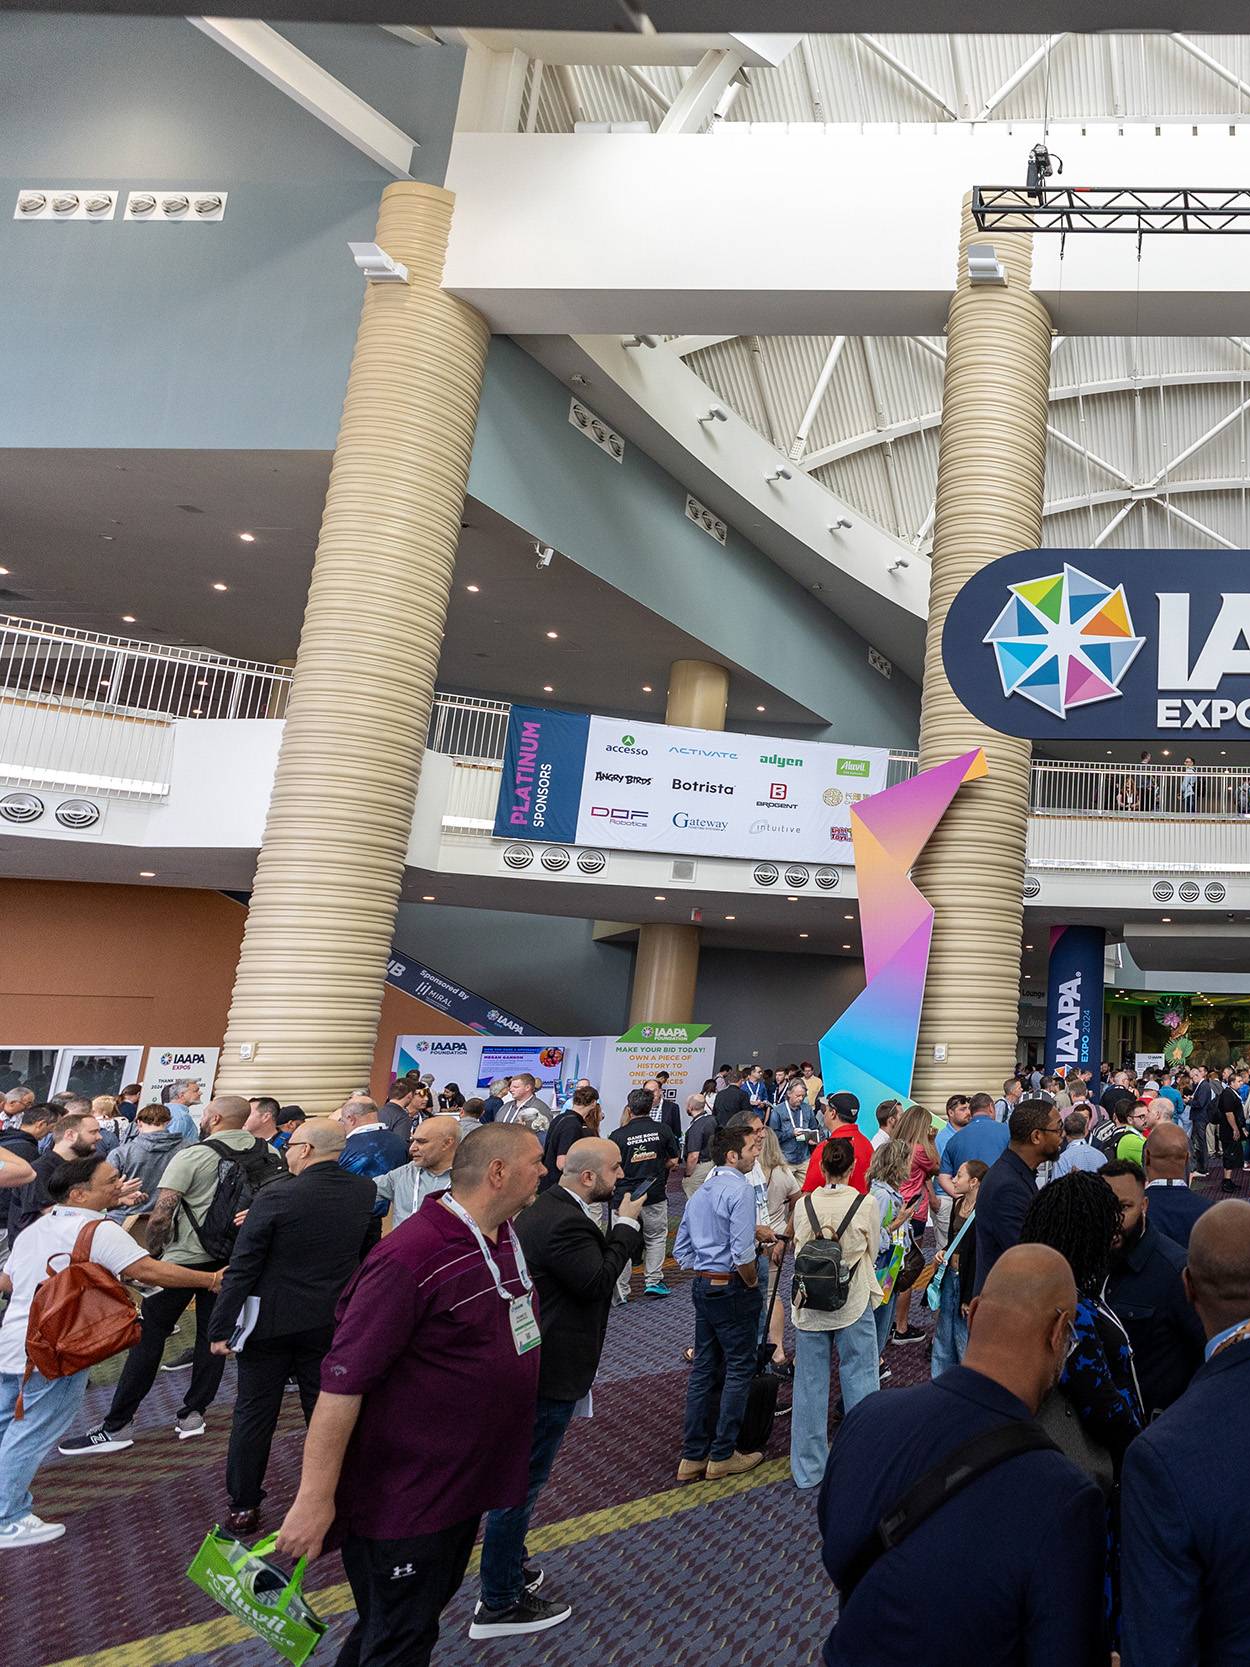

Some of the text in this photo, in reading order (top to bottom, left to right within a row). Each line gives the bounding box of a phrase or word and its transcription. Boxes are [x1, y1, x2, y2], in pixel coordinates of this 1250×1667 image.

[605, 743, 649, 756] accesso
[759, 754, 803, 768] adyen
[510, 721, 542, 826] PLATINUM
[595, 771, 652, 786] ANGRY BIRDS
[672, 779, 735, 795] Botrista
[533, 763, 552, 828] SPONSORS
[756, 800, 798, 810] BROGENT
[591, 806, 649, 820] DOF
[609, 818, 647, 828] Robotics
[672, 812, 729, 831] Gateway
[756, 823, 801, 834] intuitive
[420, 969, 470, 1000] Sponsored By
[428, 990, 453, 1007] MIRAL
[496, 1015, 524, 1035] IAAPA
[1056, 977, 1082, 1063] IAAPA
[654, 1027, 688, 1036] IAAPA
[1081, 1009, 1091, 1063] EXPO 2024
[430, 1042, 467, 1051] IAAPA
[174, 1053, 206, 1064] IAAPA
[626, 1136, 660, 1146] OPERATOR
